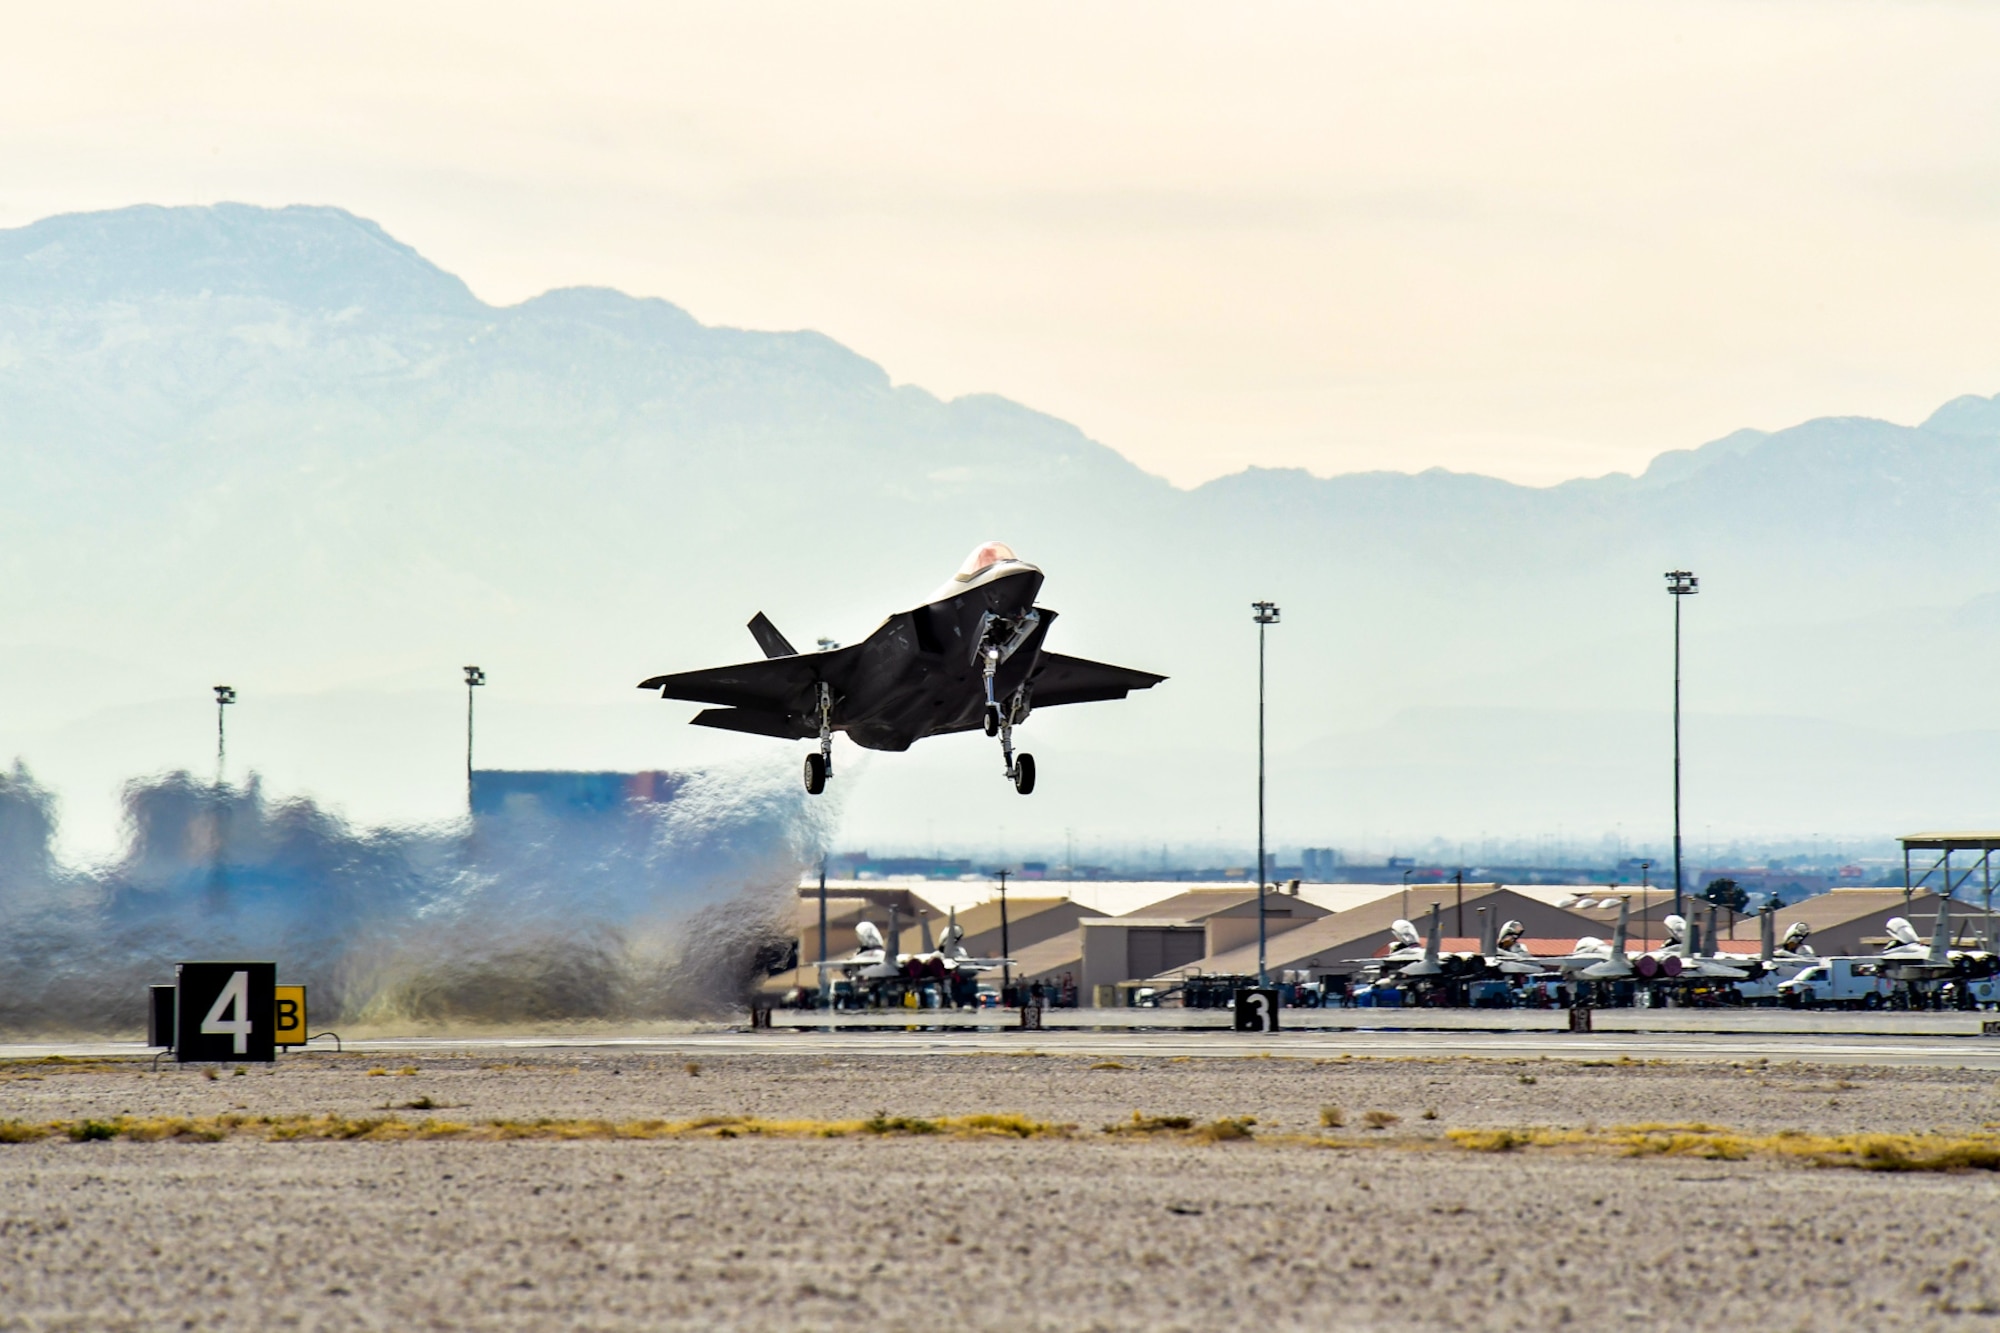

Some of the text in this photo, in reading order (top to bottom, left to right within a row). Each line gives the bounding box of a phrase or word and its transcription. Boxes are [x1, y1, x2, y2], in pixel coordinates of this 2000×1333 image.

[201, 971, 252, 1054] 4
[277, 999, 299, 1031] B
[1245, 993, 1271, 1032] 3
